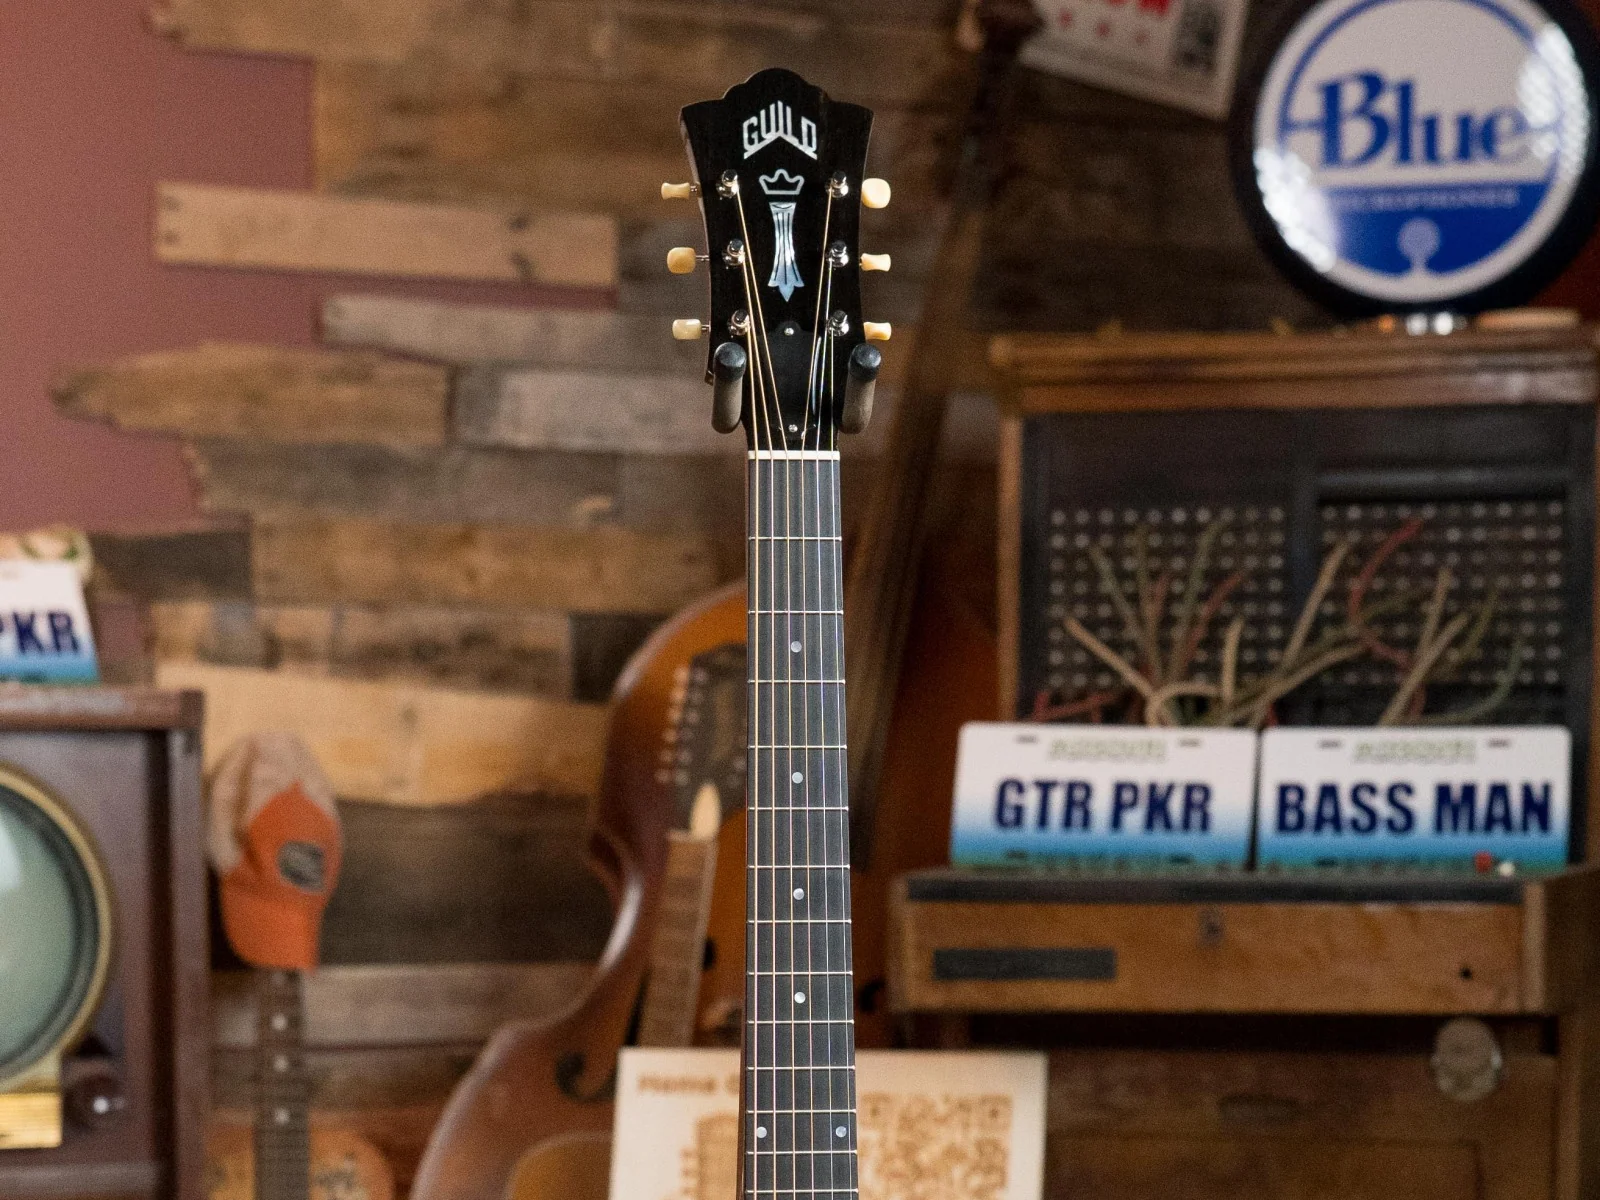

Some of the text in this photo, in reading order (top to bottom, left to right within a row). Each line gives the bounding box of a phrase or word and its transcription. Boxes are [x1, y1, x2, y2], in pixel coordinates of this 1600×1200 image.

[743, 100, 817, 157] GUILD
[1317, 69, 1524, 167] Blue
[995, 778, 1213, 832] GTR PKR
[1276, 780, 1551, 834] BASS MAN
